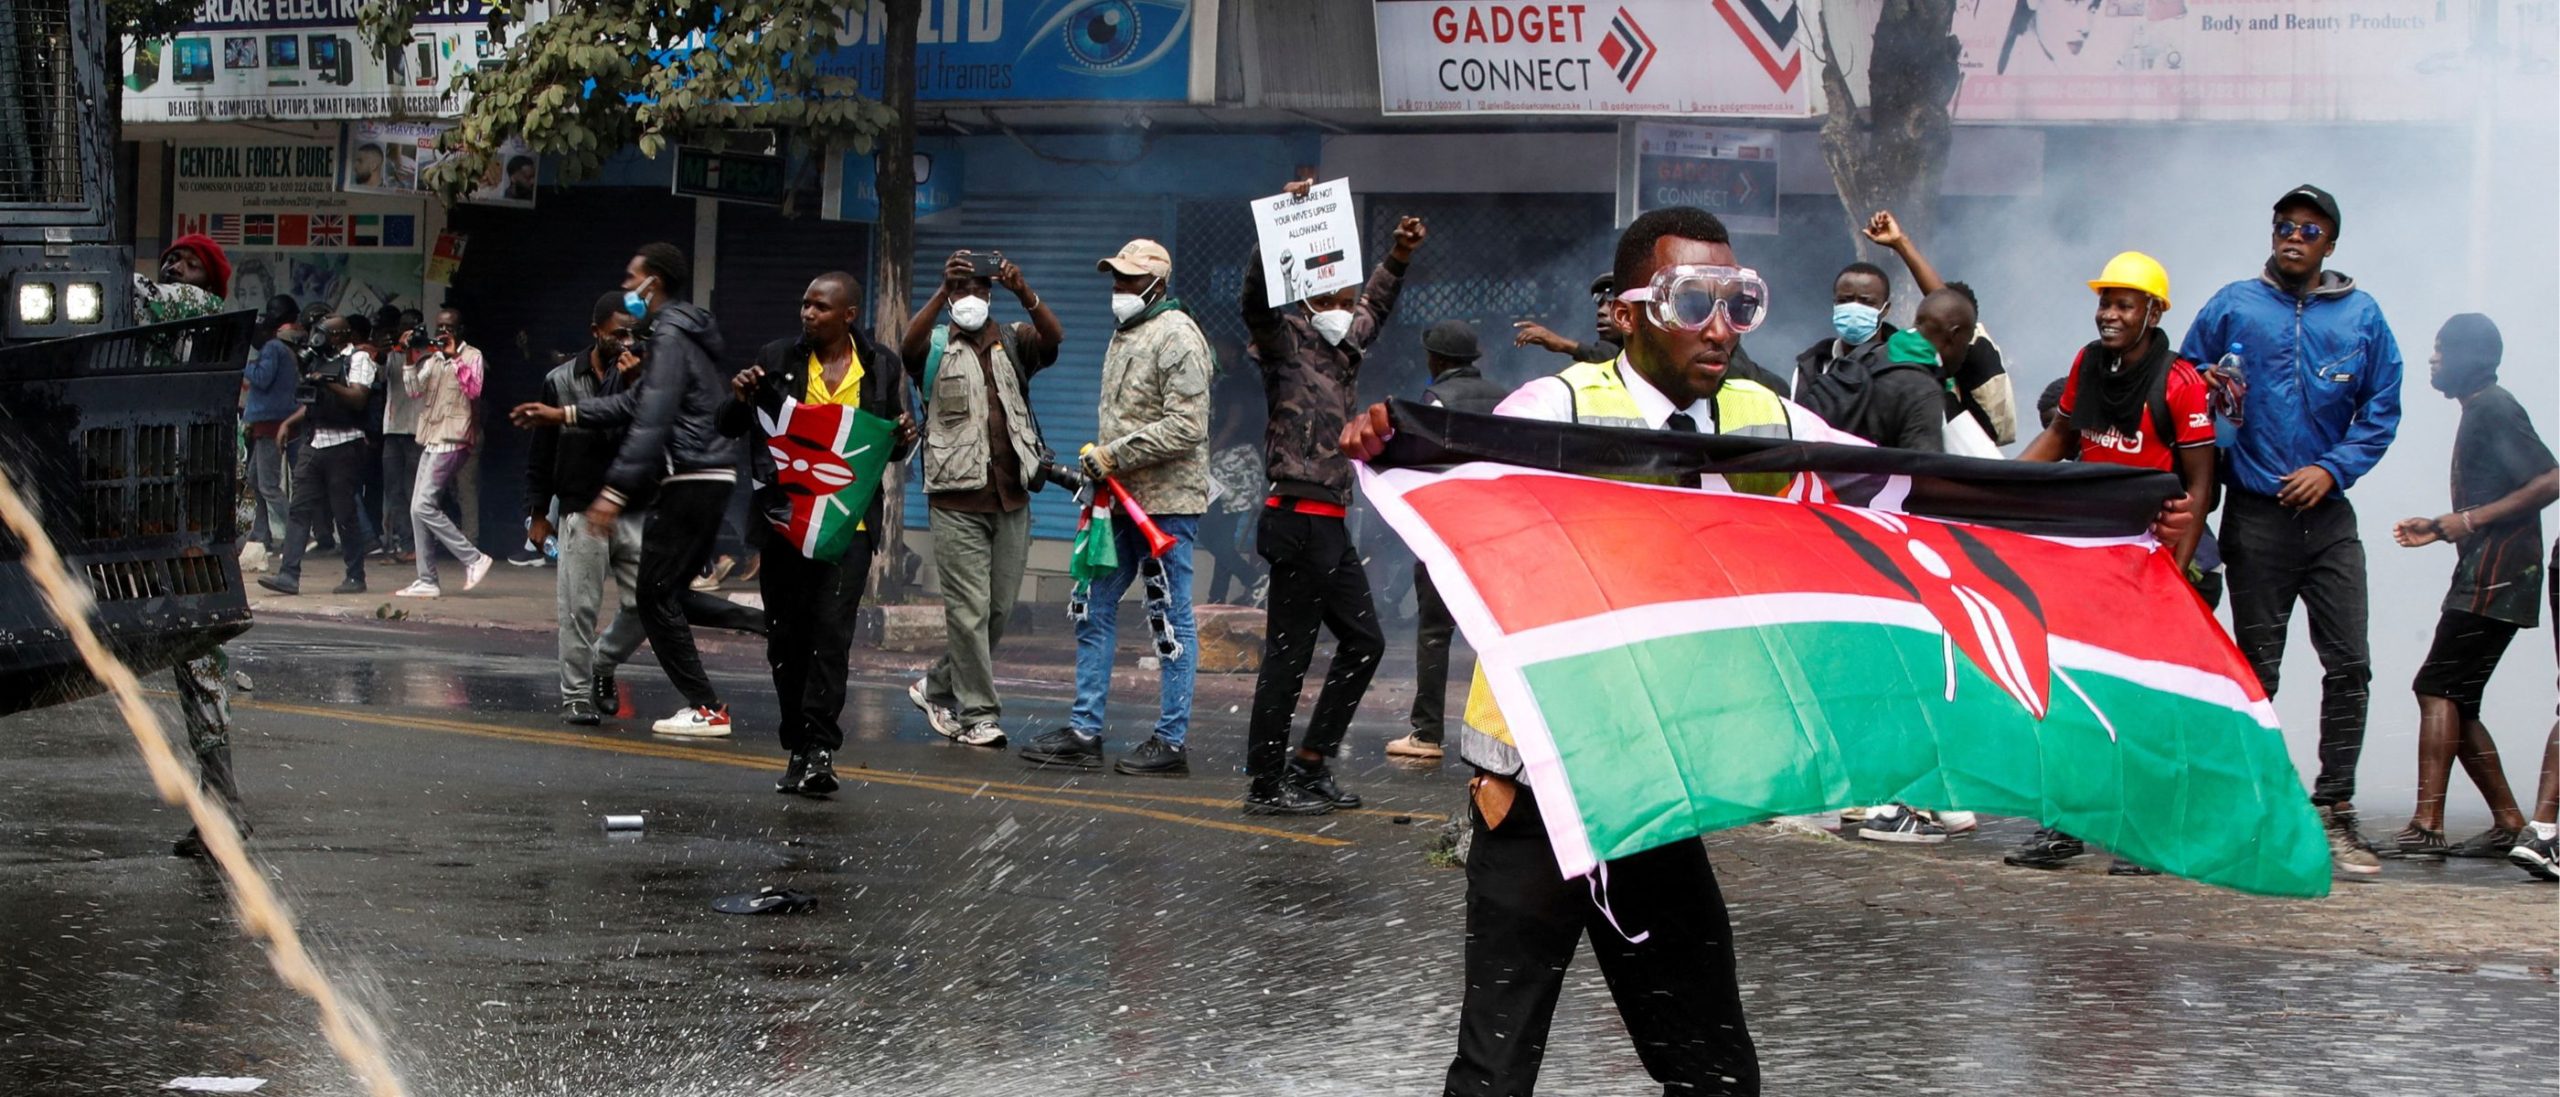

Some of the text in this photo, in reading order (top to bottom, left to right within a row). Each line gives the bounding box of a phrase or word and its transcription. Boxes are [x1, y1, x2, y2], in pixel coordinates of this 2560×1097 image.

[1432, 5, 1585, 43] GADGET
[2201, 12, 2427, 35] Body and Beauty Products
[937, 51, 1012, 90] frames
[1438, 58, 1591, 91] CONNECT
[167, 101, 203, 117] DEALERS
[313, 97, 342, 114] SMART
[345, 97, 378, 114] PHONES
[381, 97, 400, 113] AND
[402, 96, 460, 113] ACCESSORIES
[180, 146, 241, 178] CENTRAL
[246, 146, 292, 177] FOREX
[1657, 160, 1729, 183] GADGET
[178, 181, 189, 192] NO
[191, 181, 232, 192] COMMISSION
[234, 181, 266, 192] CHARGED
[1657, 187, 1729, 207] CONNECT
[1273, 200, 1286, 211] OUR
[1306, 191, 1319, 203] ARE
[1319, 187, 1333, 199] NOT
[1274, 214, 1291, 226] YOUR
[1313, 202, 1337, 217] UPKEEP
[1289, 221, 1328, 239] ALLOWANCE
[1310, 236, 1336, 253] REJECT
[1317, 264, 1336, 281] AMEND
